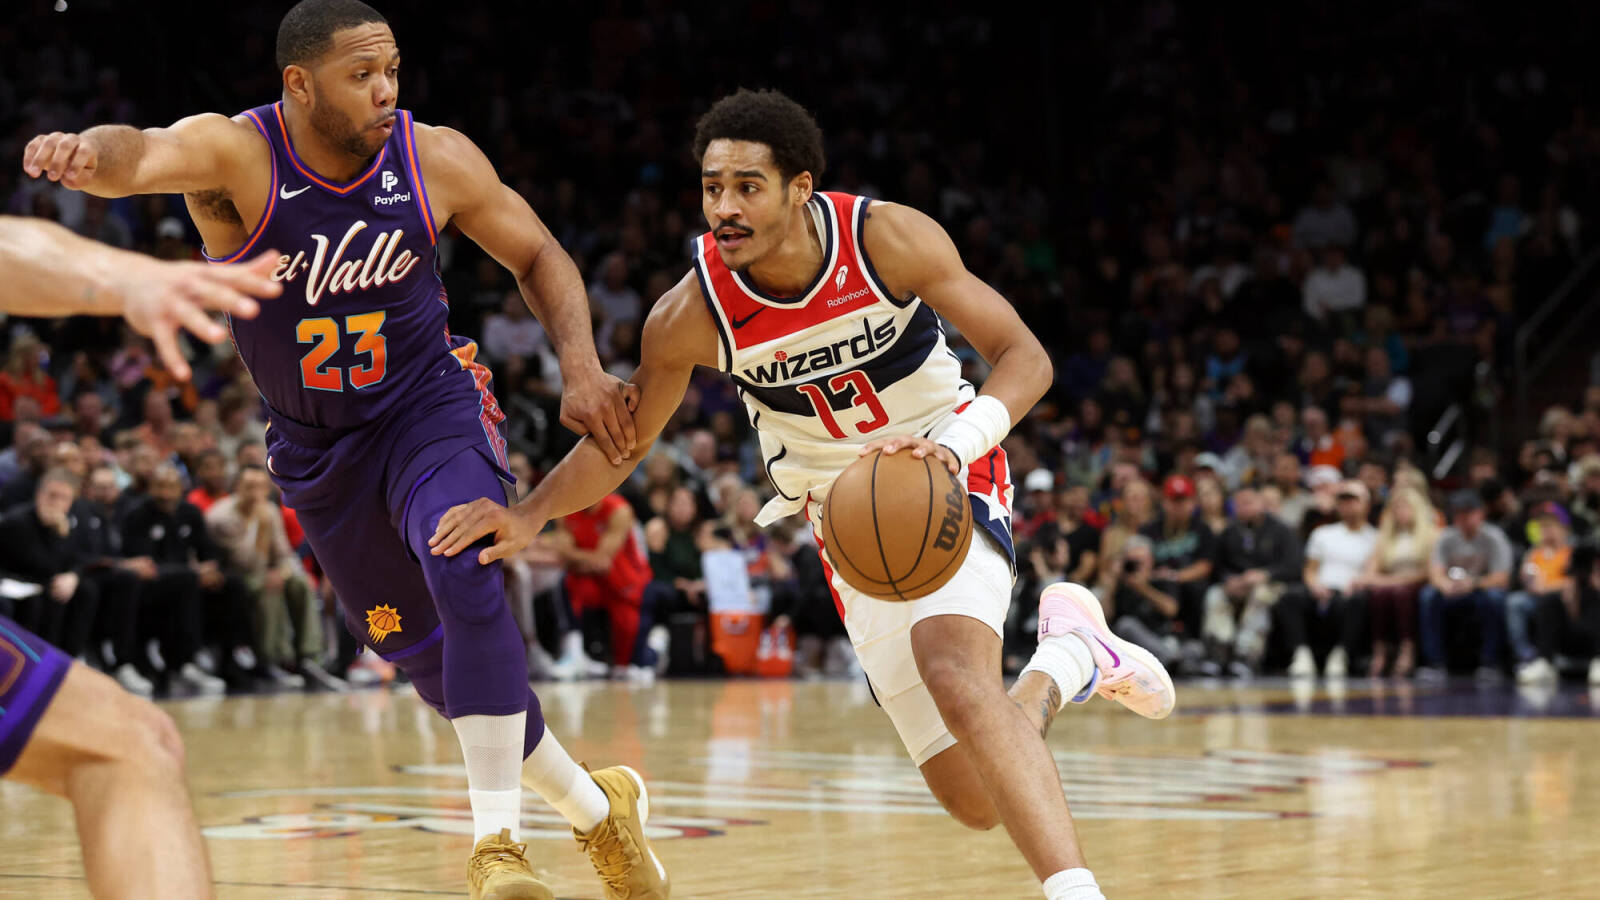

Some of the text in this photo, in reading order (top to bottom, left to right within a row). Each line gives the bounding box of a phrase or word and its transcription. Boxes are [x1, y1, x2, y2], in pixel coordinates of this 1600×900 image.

[374, 191, 411, 206] PayPal
[305, 220, 420, 306] Valle
[826, 286, 870, 308] Robinhood
[296, 310, 387, 392] 23
[796, 369, 889, 440] 13
